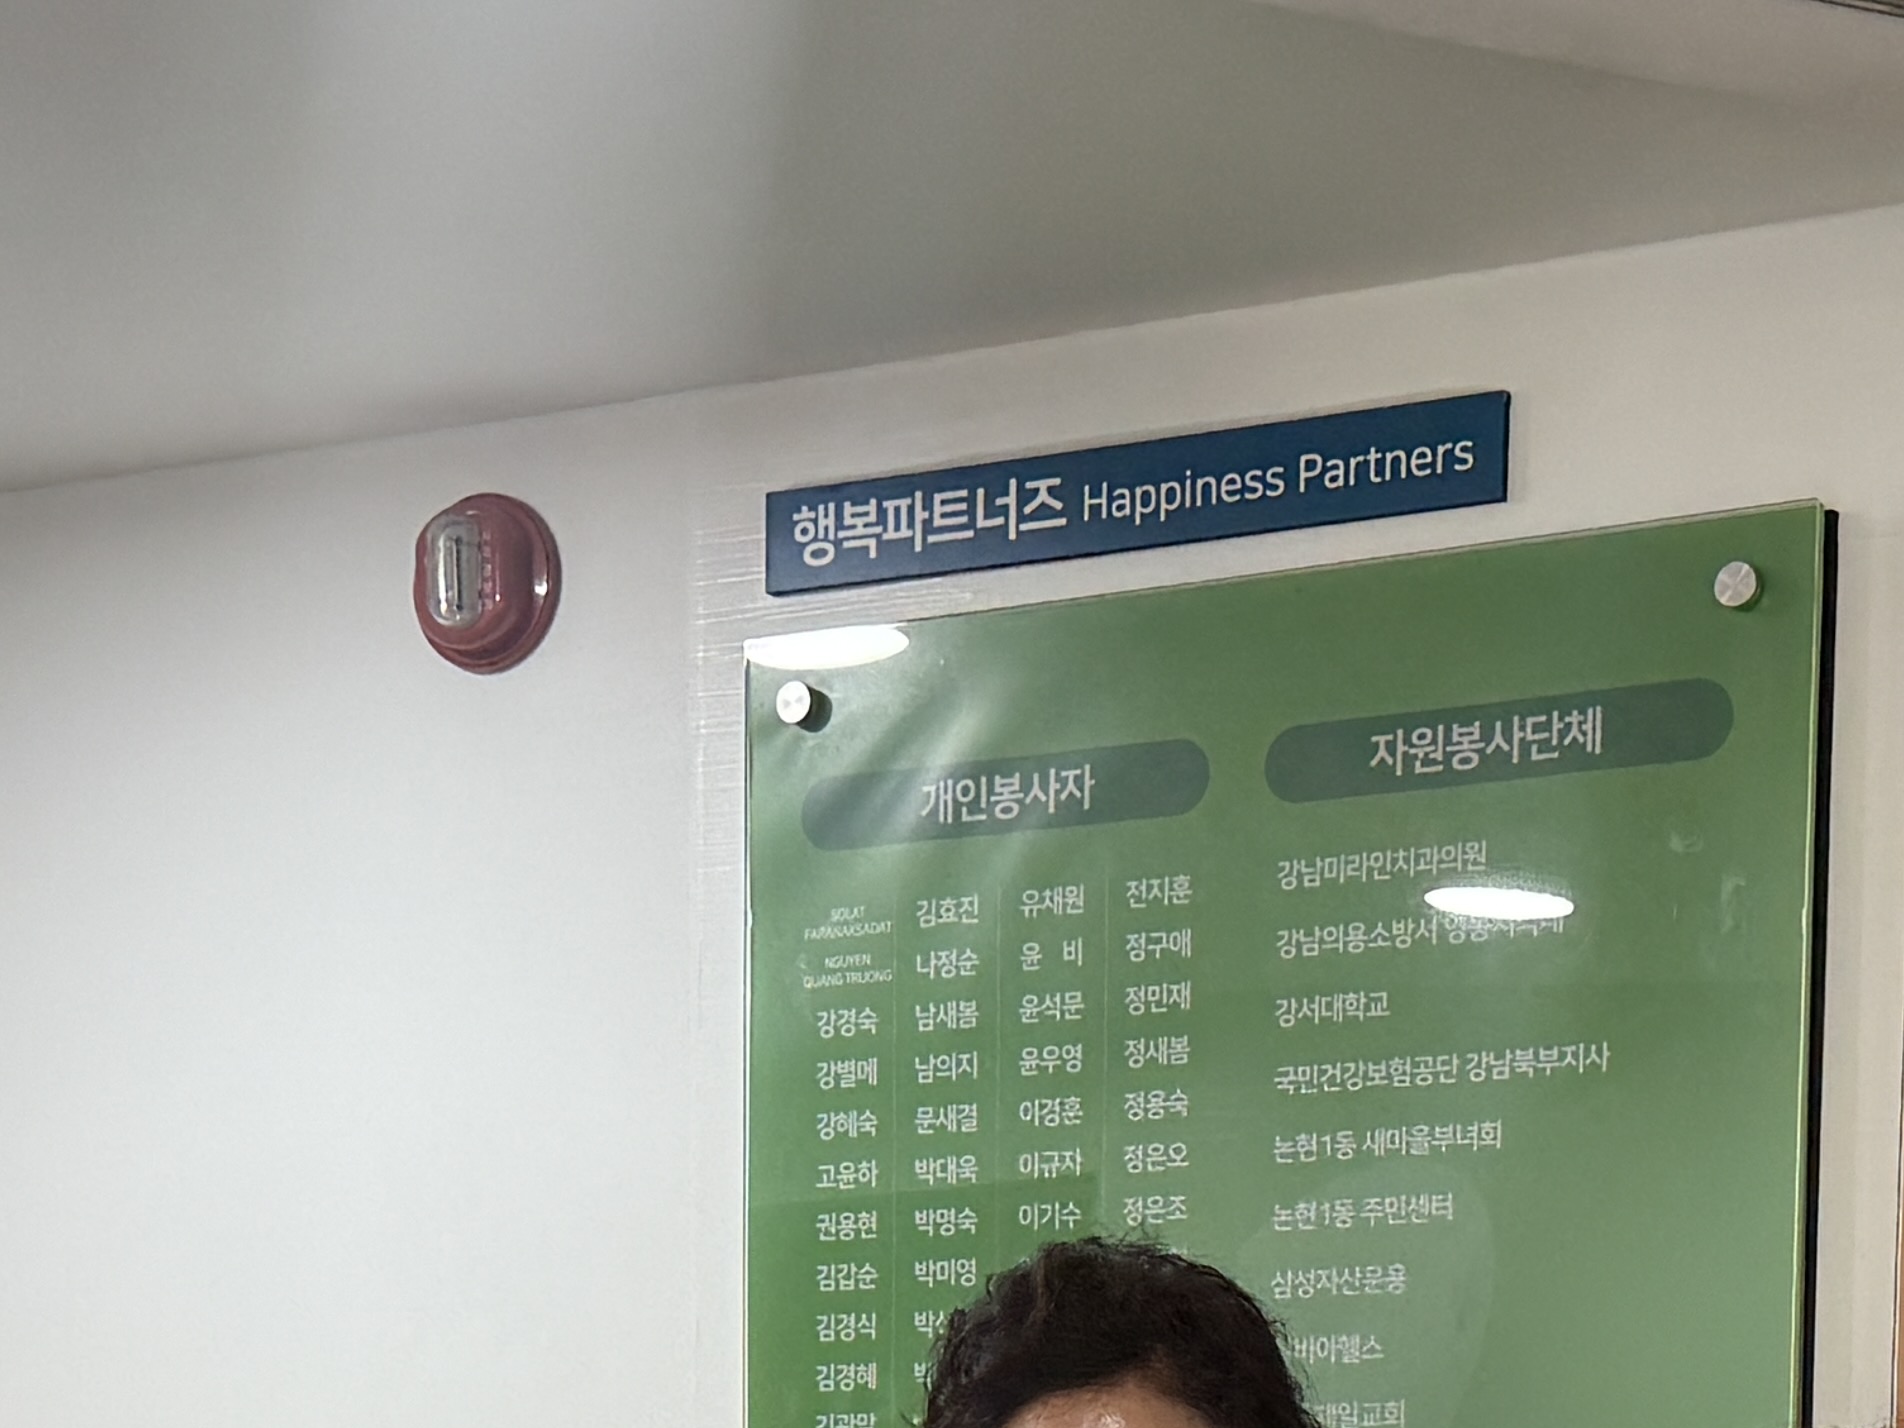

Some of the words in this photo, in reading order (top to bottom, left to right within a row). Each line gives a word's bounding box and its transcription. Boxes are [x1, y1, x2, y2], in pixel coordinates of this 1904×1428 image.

[793, 478, 1067, 566] 행복파트너즈
[1084, 467, 1284, 525] Happiness
[1300, 441, 1473, 492] Partners
[1370, 706, 1602, 777] 자원봉사단체
[921, 762, 1095, 827] 개인봉사자
[1278, 841, 1487, 890] 강남미라인치과의원
[1126, 875, 1193, 908] 전지훈
[916, 895, 979, 928] 김효진
[1126, 930, 1192, 963] 정구애
[917, 948, 979, 979] 나정순
[1125, 982, 1192, 1015] 정민재
[1275, 992, 1390, 1027] 강서대학교
[817, 1008, 879, 1038] 강경숙
[915, 1001, 979, 1032] 남새봄
[1019, 1044, 1083, 1075] 윤우영
[1274, 1055, 1459, 1094] 국민건강보험공단
[1466, 1041, 1610, 1082] 강남북부지사
[816, 1160, 879, 1189] 고윤하
[1019, 1202, 1081, 1231] 이기수
